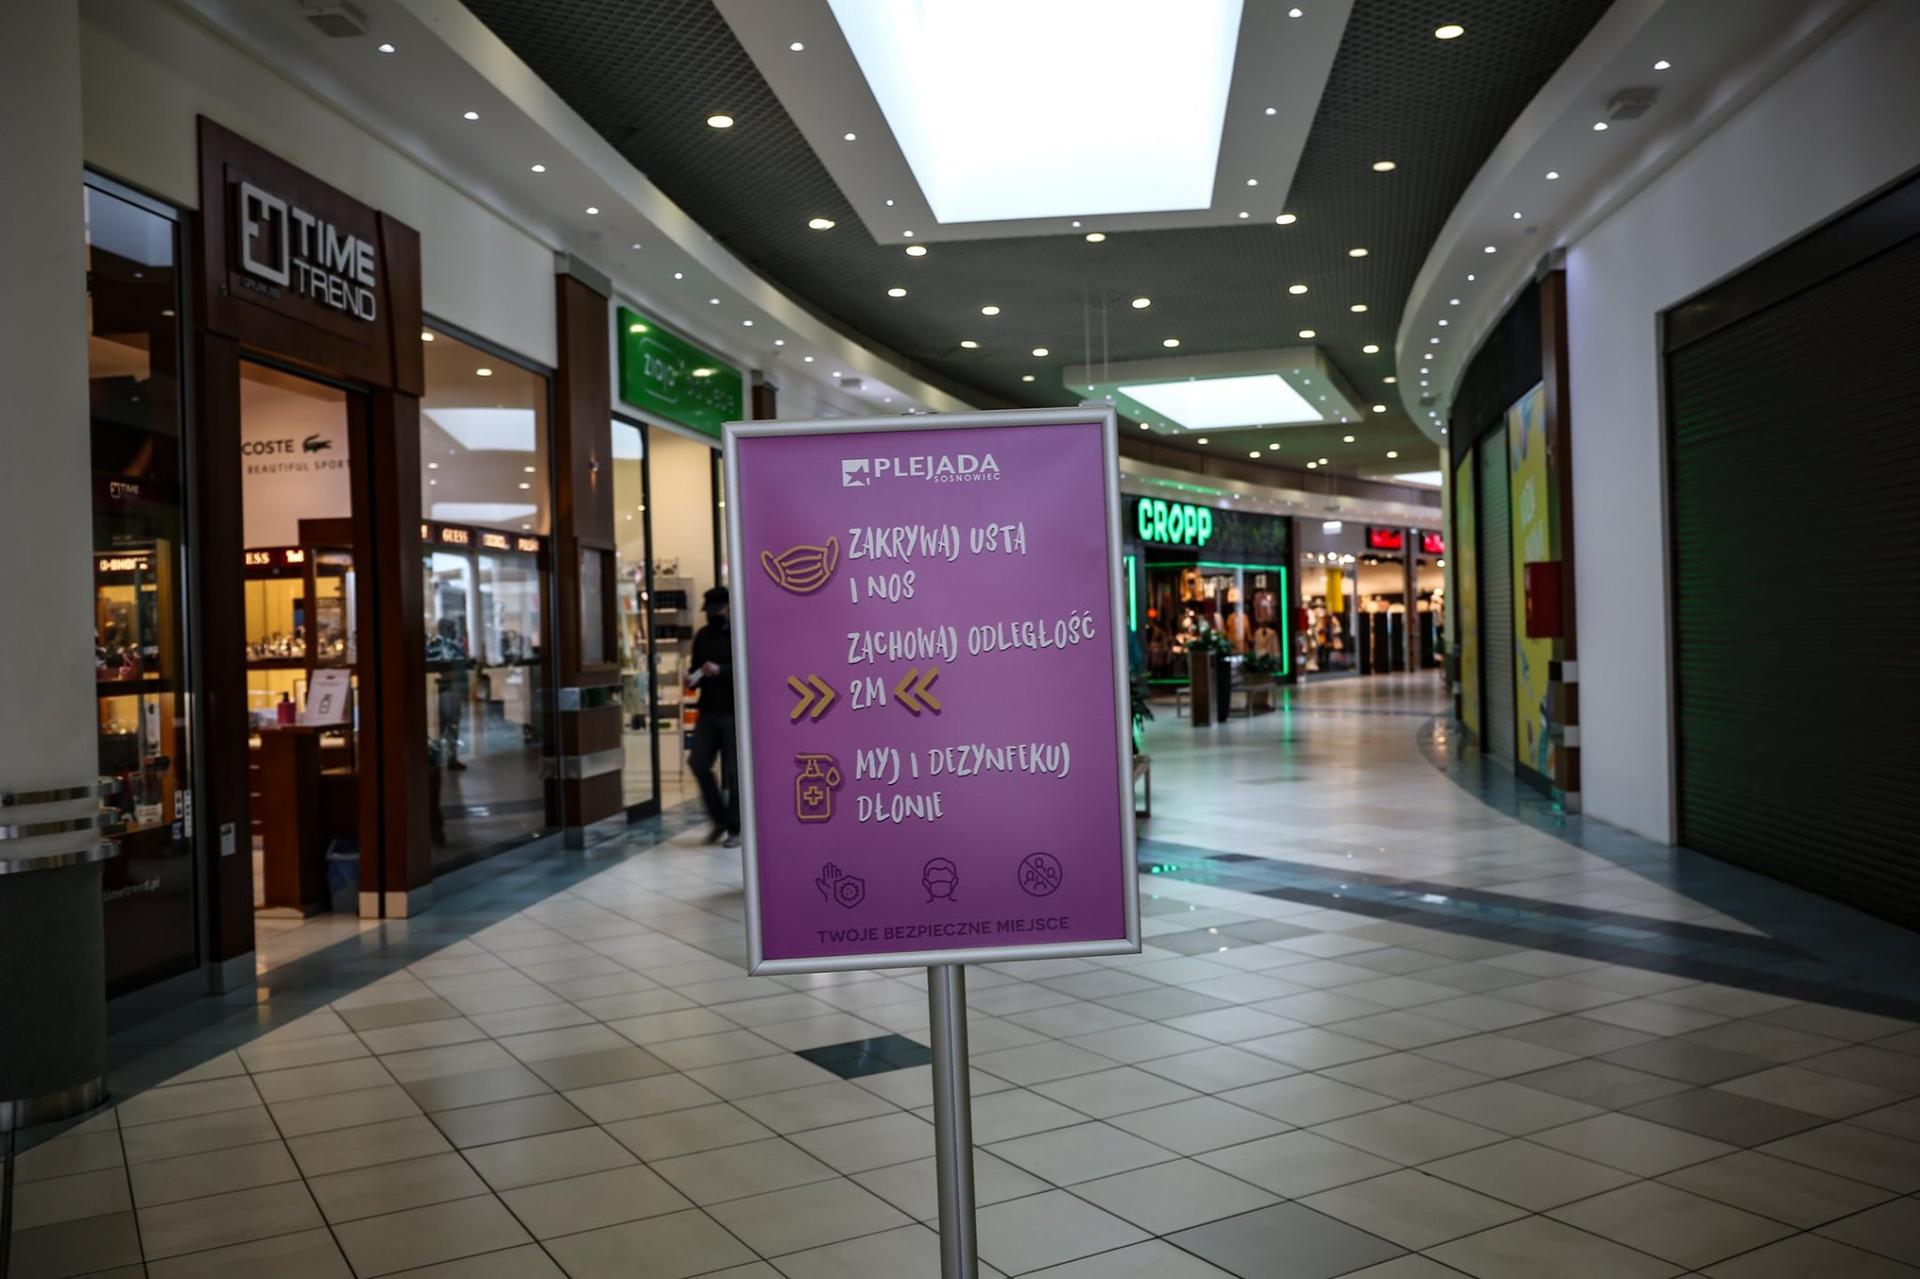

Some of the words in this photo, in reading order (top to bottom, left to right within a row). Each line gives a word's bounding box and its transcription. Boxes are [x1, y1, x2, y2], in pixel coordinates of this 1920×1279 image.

[291, 205, 376, 288] TIME
[291, 257, 377, 322] TREND
[241, 439, 294, 456] COSTE
[247, 463, 309, 474] BEAUTIFUL
[873, 453, 1000, 481] PLEJADA
[933, 472, 1001, 483] SOSNOWIEC
[1138, 497, 1213, 547] CROPP
[245, 551, 270, 565] ESS
[848, 524, 961, 563] ZAKRYWAJ
[969, 521, 1027, 556] USTA
[849, 577, 859, 604] I
[867, 569, 916, 603] NOS
[847, 624, 958, 664] ZACHOWAJ
[968, 610, 1095, 656] ODLEGŁOŚĆ
[850, 675, 887, 710] 2M
[855, 746, 901, 786] MYJ
[928, 741, 1071, 779] DEZYNFEKUJ
[856, 791, 944, 824] DŁONIE
[816, 928, 879, 944] TWOJE
[884, 921, 992, 941] BEZPIECZNE
[996, 916, 1070, 933] MIEJSCE
